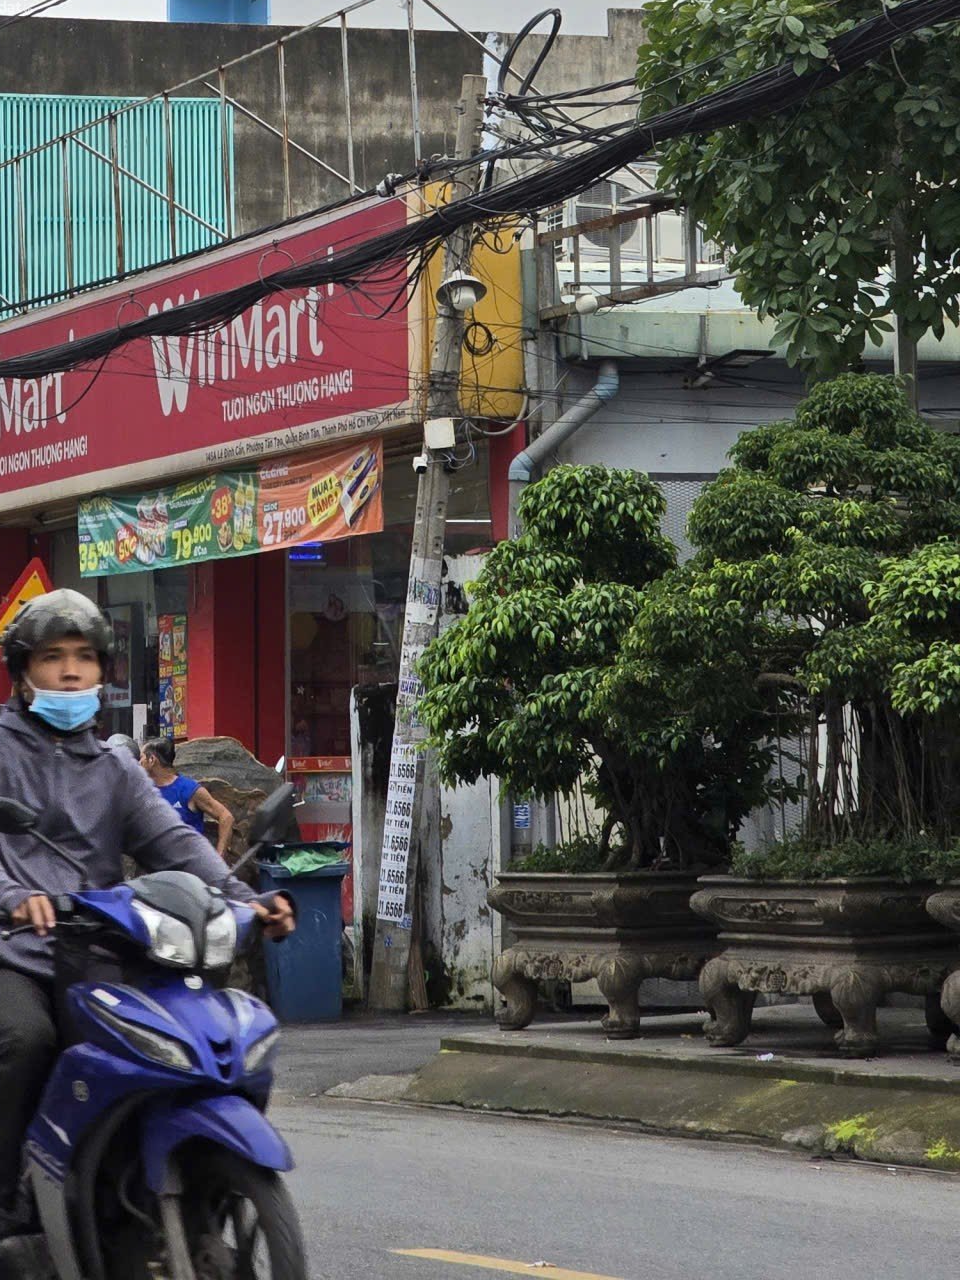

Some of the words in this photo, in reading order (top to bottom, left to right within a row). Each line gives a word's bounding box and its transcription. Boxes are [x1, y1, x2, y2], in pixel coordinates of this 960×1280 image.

[246, 389, 276, 418] NGON
[320, 369, 354, 402] HẠNG!
[8, 450, 30, 474] NGON
[63, 435, 88, 463] HẠNG!
[311, 482, 329, 500] MUA
